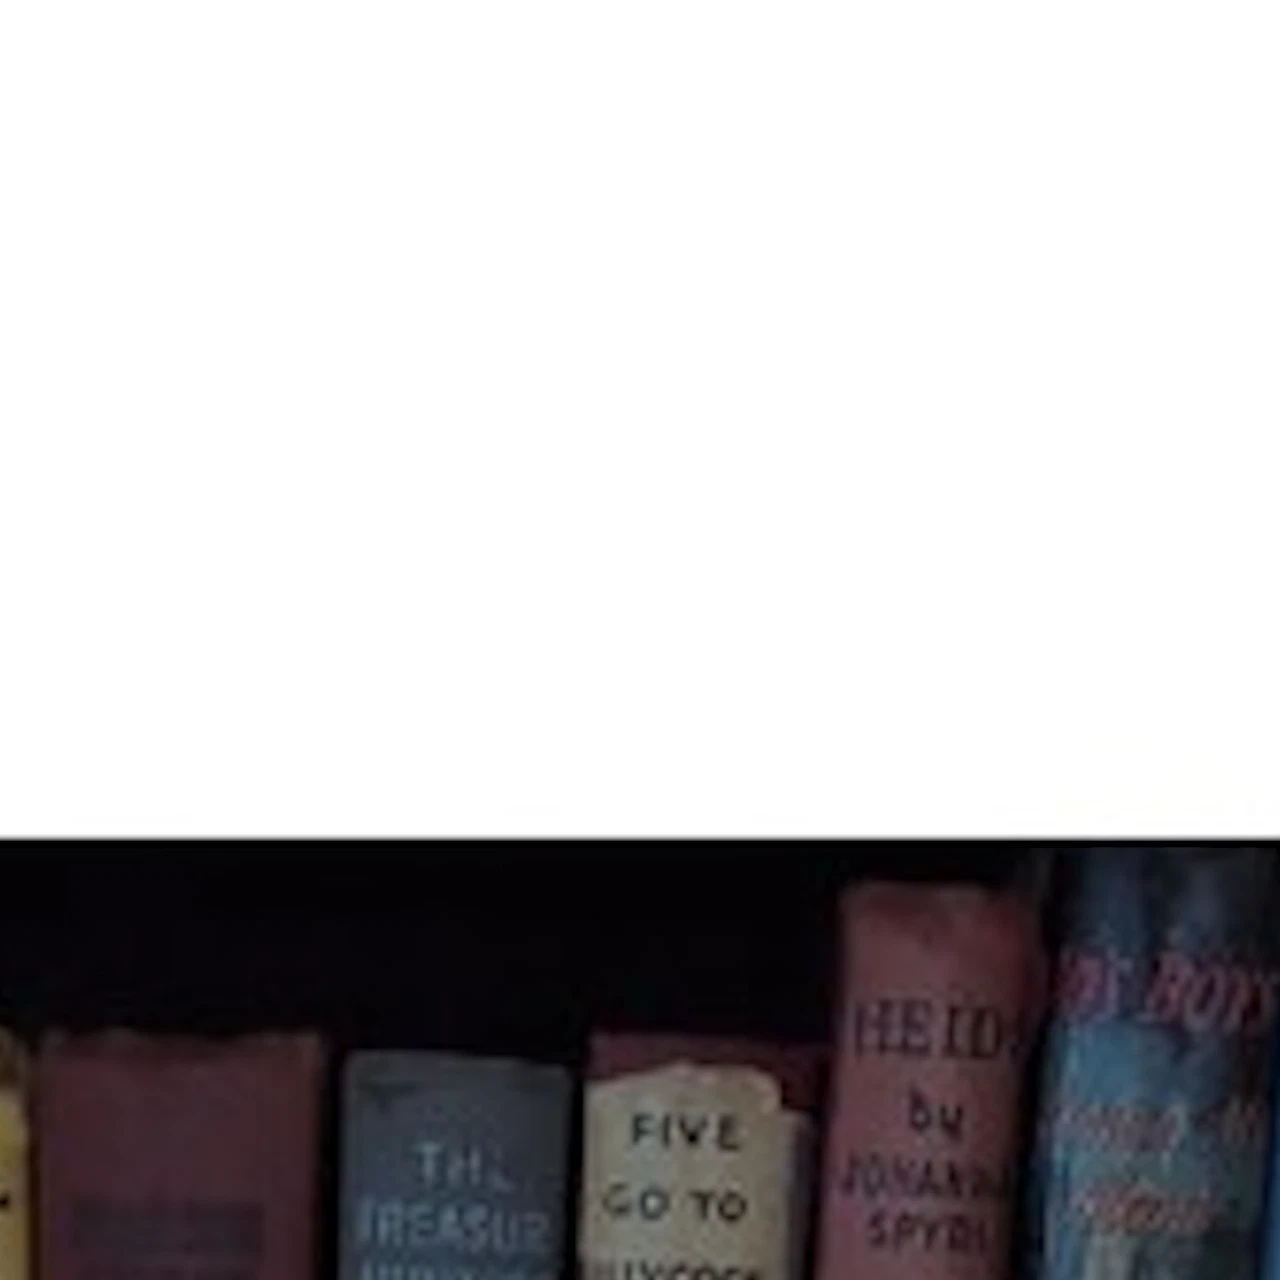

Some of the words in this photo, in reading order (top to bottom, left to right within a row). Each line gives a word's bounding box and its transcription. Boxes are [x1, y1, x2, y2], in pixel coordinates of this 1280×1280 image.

[630, 1113, 742, 1150] FIVE
[908, 1090, 963, 1142] by
[600, 1186, 668, 1222] GO
[687, 1190, 750, 1223] TO
